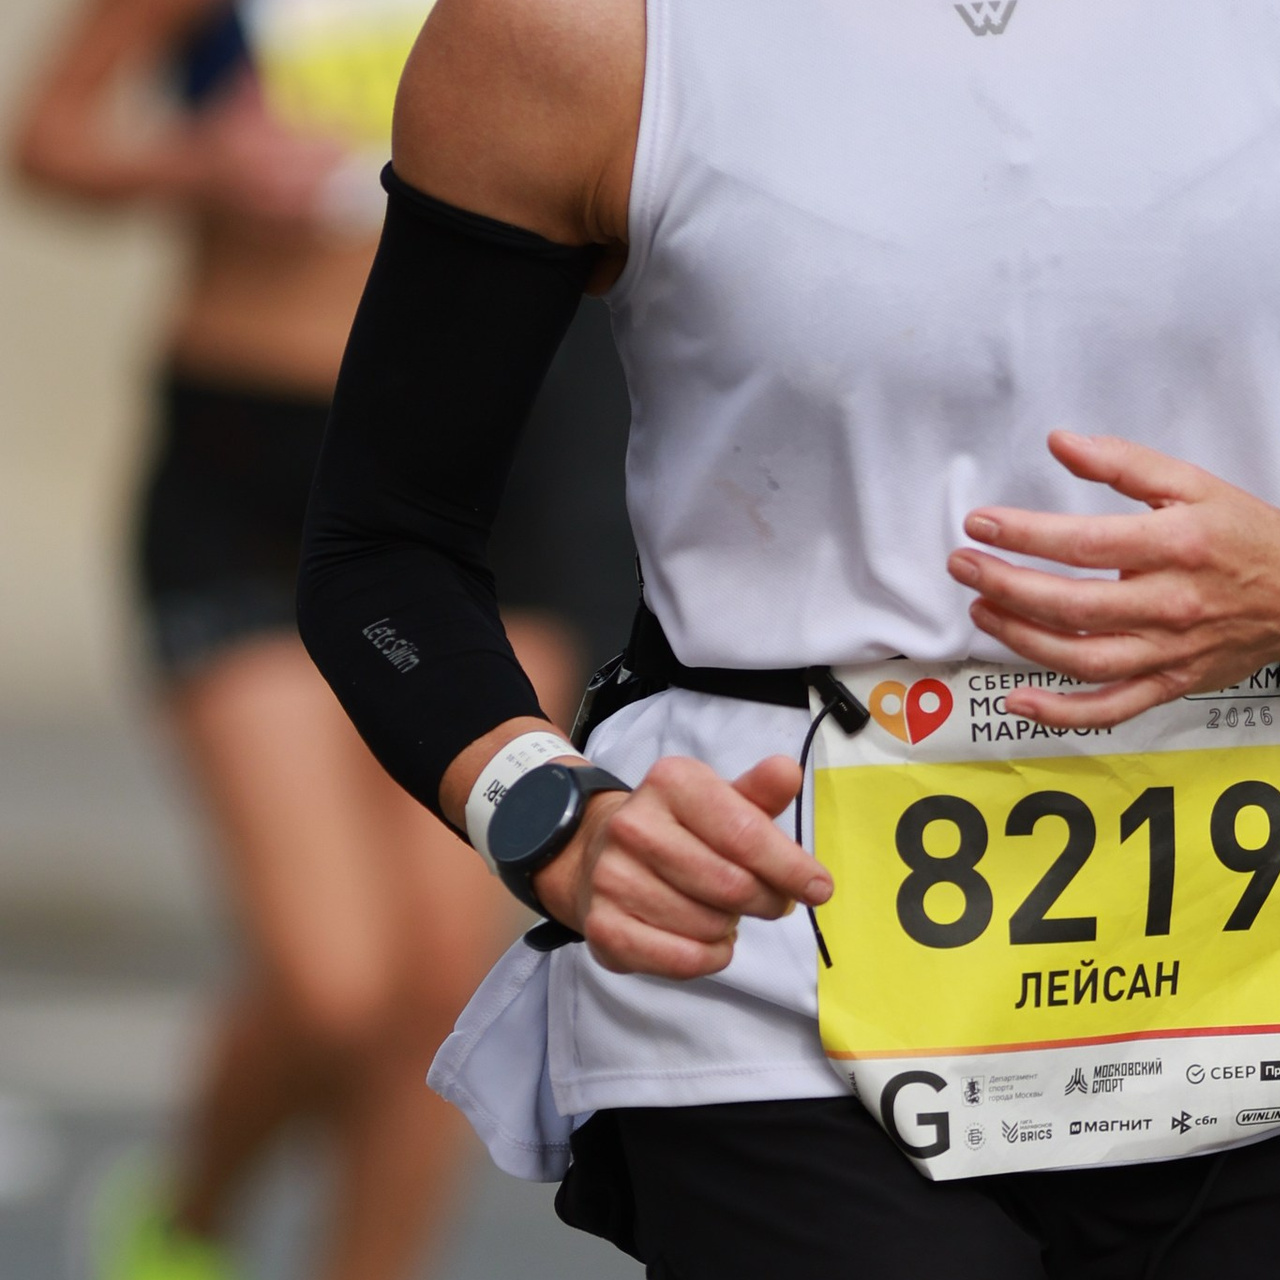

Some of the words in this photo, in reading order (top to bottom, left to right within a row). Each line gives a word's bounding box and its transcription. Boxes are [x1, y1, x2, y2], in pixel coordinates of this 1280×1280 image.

[968, 671, 1090, 692] СБЕРПРА
[1206, 705, 1273, 729] 2026
[1014, 959, 1181, 1010] ЛЕЙСАН
[1092, 1057, 1163, 1079] МОСКОВСКИЙ
[1210, 1065, 1257, 1080] СБЕР
[988, 1072, 1039, 1085] Департамент
[1092, 1077, 1125, 1094] СПОРТ
[988, 1084, 1014, 1094] спорта
[988, 1093, 1013, 1103] города
[1014, 1091, 1044, 1100] Москвы
[879, 1069, 951, 1160] G
[1194, 1115, 1218, 1126] сбп
[1084, 1116, 1153, 1133] магнит
[1019, 1128, 1053, 1143] BRICS
